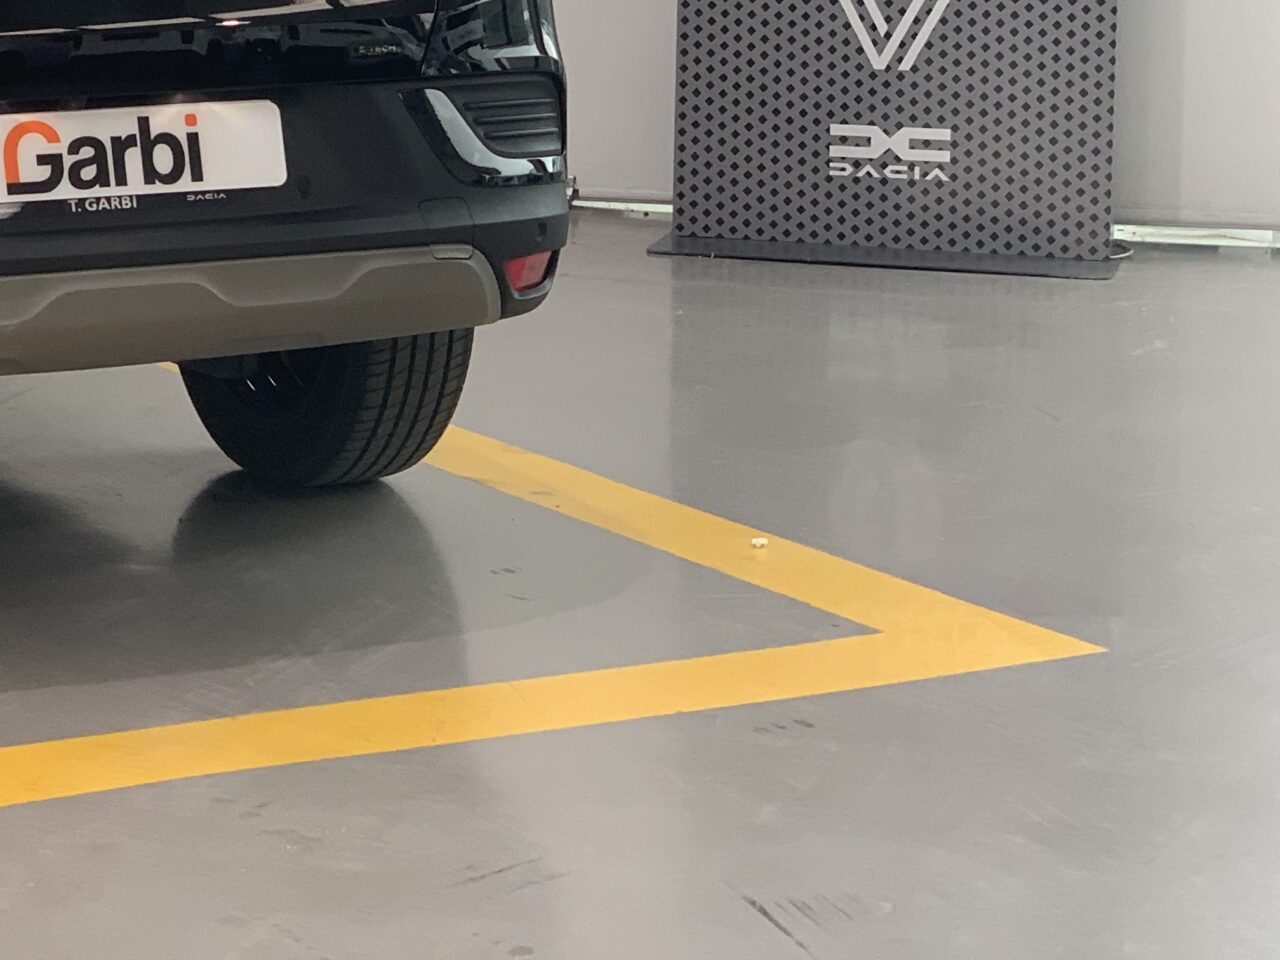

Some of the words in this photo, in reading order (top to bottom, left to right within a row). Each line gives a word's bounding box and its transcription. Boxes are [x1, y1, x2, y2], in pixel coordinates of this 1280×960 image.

[3, 113, 204, 196] Garbi
[829, 162, 950, 181] DACIA
[68, 199, 82, 213] T.
[85, 195, 138, 212] GARBI
[186, 192, 227, 201] DACIA
